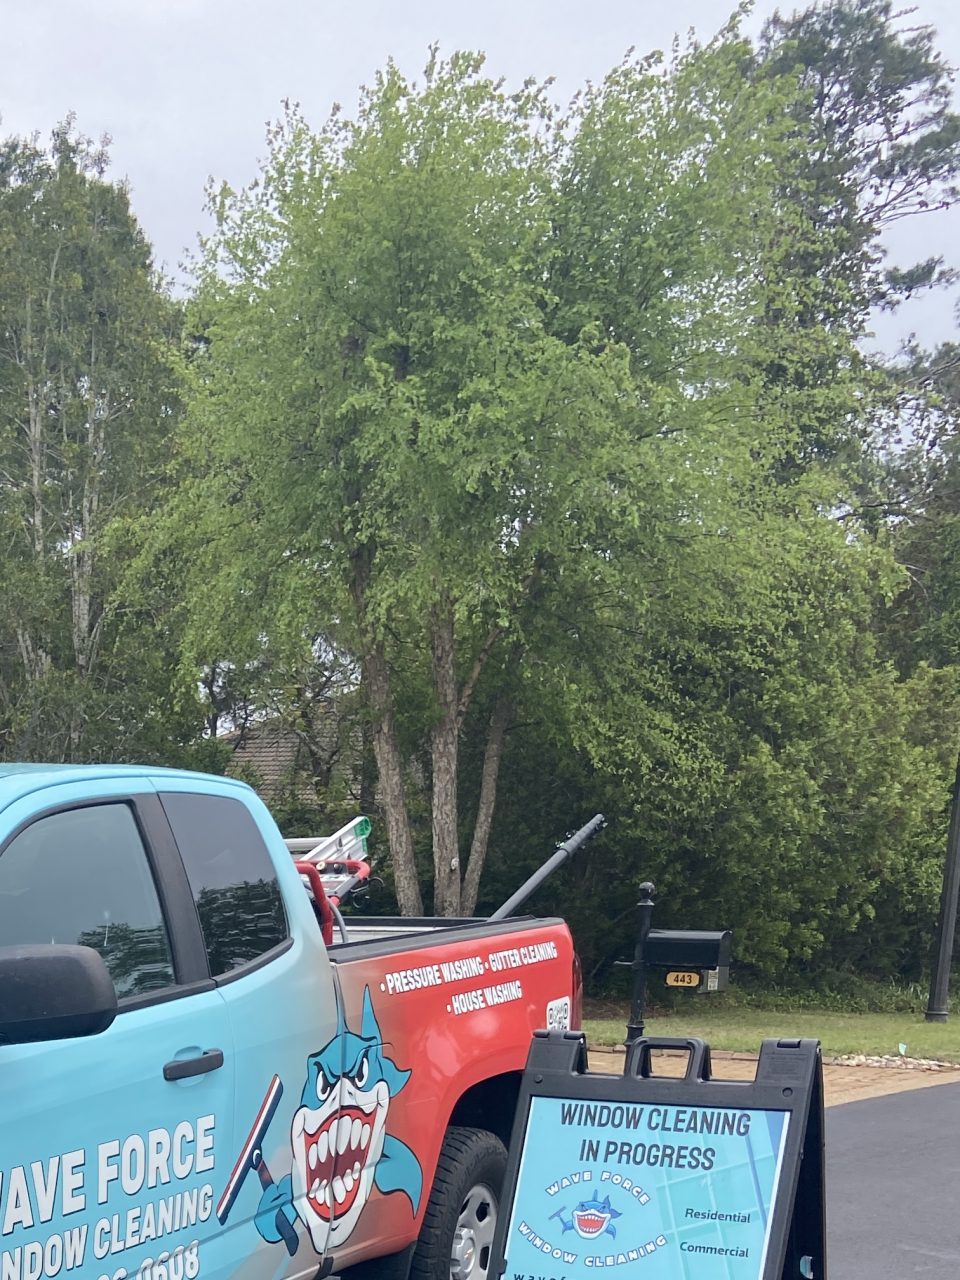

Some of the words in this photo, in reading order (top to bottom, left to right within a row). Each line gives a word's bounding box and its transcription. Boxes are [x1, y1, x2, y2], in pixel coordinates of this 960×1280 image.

[385, 964, 441, 995] PRESSURE
[440, 956, 484, 983] WASHING
[488, 949, 521, 972] GUTTER
[520, 941, 558, 964] CLEANING
[673, 974, 692, 984] 443
[451, 989, 485, 1015] HOUSE
[484, 980, 522, 1006] WASHING
[561, 1103, 644, 1130] WINDOW
[647, 1108, 751, 1137] CLEANING
[97, 1113, 215, 1204] FORCE
[579, 1139, 601, 1162] IN
[603, 1141, 716, 1171] PROGRESS
[545, 1170, 592, 1197] WAVE
[600, 1170, 651, 1206] FORCE
[92, 1183, 213, 1260] CLEANING
[684, 1208, 751, 1224] Residential
[518, 1221, 577, 1264] WINDOW
[584, 1234, 668, 1268] CLEANING
[679, 1241, 749, 1258] Commercial
